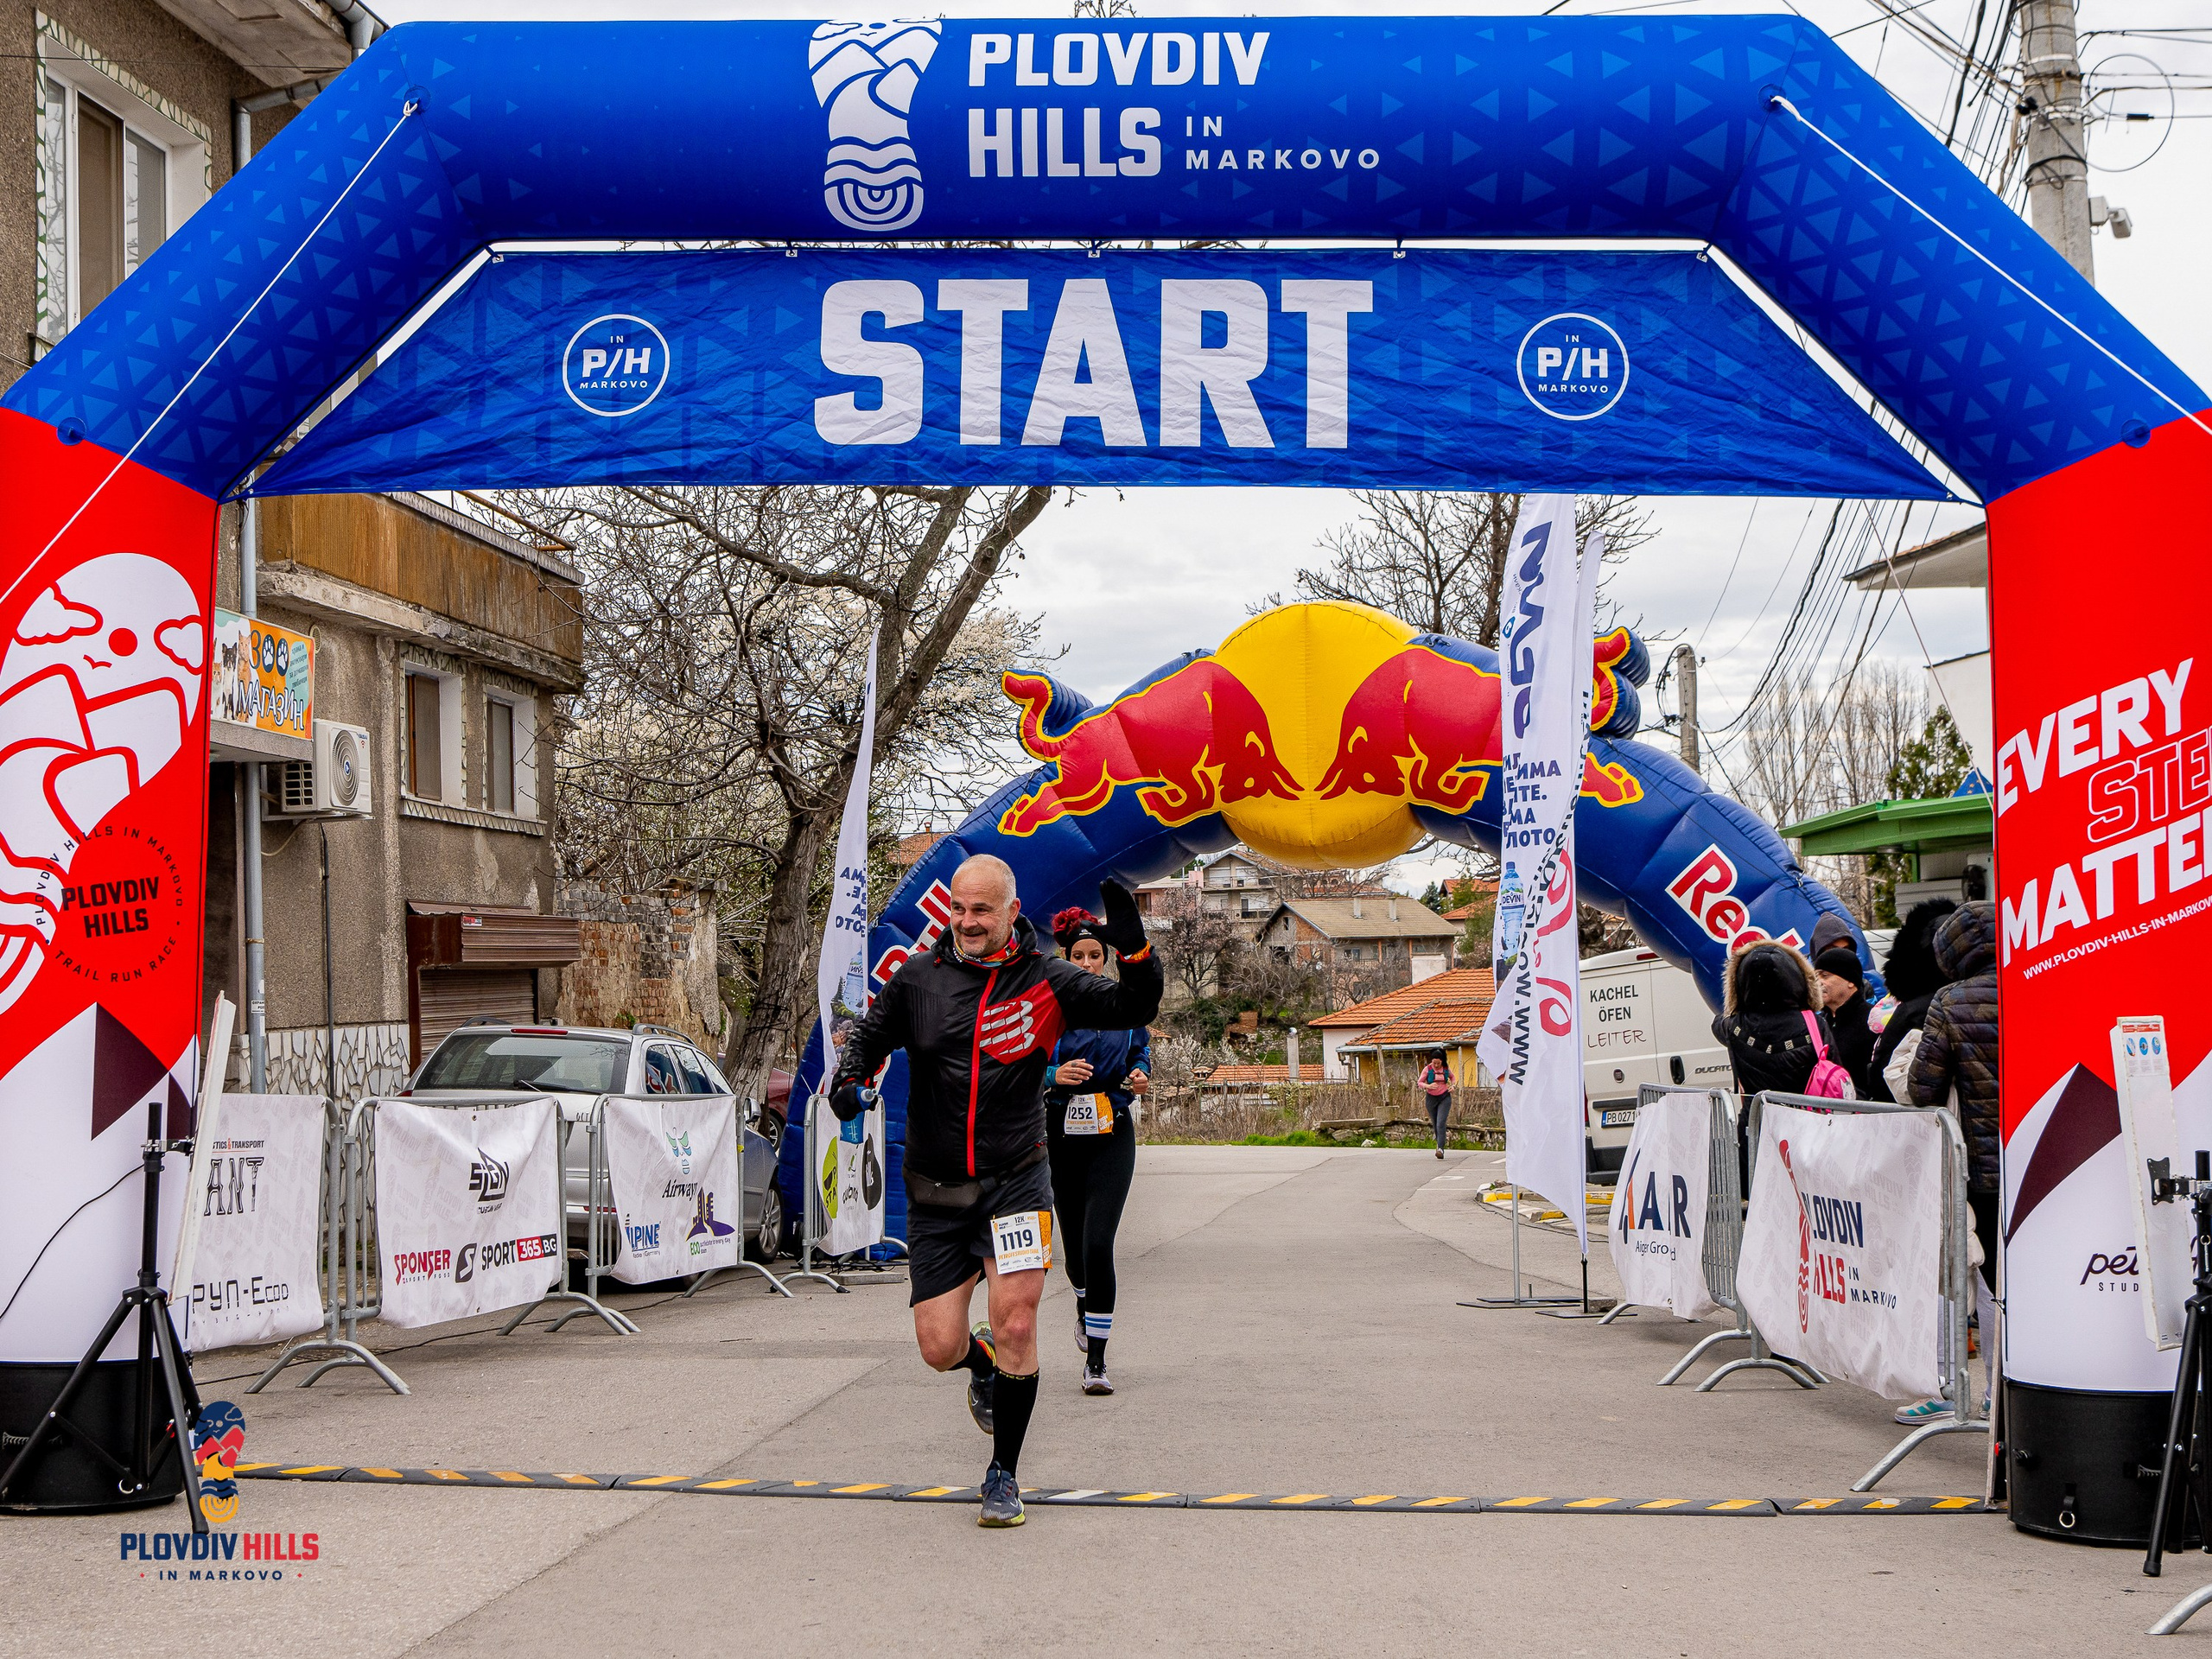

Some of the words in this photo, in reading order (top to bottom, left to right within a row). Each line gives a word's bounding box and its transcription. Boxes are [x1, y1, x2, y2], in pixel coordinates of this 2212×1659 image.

[969, 32, 1270, 86] PLOVDIV
[1185, 116, 1223, 137] IN
[969, 107, 1160, 177] HILLS
[1185, 149, 1380, 169] MARKOVO
[610, 335, 624, 344] IN
[1565, 334, 1580, 343] IN
[582, 347, 652, 378] P/H
[814, 278, 1373, 448] START
[1537, 346, 1609, 381] P/H
[579, 380, 648, 390] MARKOVO
[1538, 384, 1609, 394] MARKOVO
[238, 679, 305, 731] МАГАЗИН
[1998, 658, 2194, 818] EVERY
[2087, 724, 2212, 843] STE
[35, 853, 60, 925] PLOVDIV
[64, 826, 112, 851] HILLS
[124, 827, 140, 839] IN
[147, 836, 182, 906] MARKOVO
[61, 876, 159, 911] PLOVDIV
[1502, 893, 1522, 905] DEVIN
[84, 908, 149, 938] HILLS
[55, 950, 99, 981] TRAIL
[111, 969, 143, 982] RUN
[149, 937, 176, 970] RACE
[1590, 985, 1638, 1002] KACHEL
[1599, 1007, 1631, 1022] ÖFEN
[1587, 1029, 1647, 1048] LEITER
[1068, 1106, 1093, 1120] 1252
[1607, 1112, 1617, 1122] PB
[232, 1140, 264, 1149] TRANSPORT
[690, 1242, 700, 1255] ECO
[1000, 1229, 1033, 1251] 1119
[394, 1249, 451, 1286] SPONSER
[1848, 1266, 1859, 1281] IN
[2098, 1282, 2139, 1292] STUD
[1850, 1287, 1897, 1310] MARKVO
